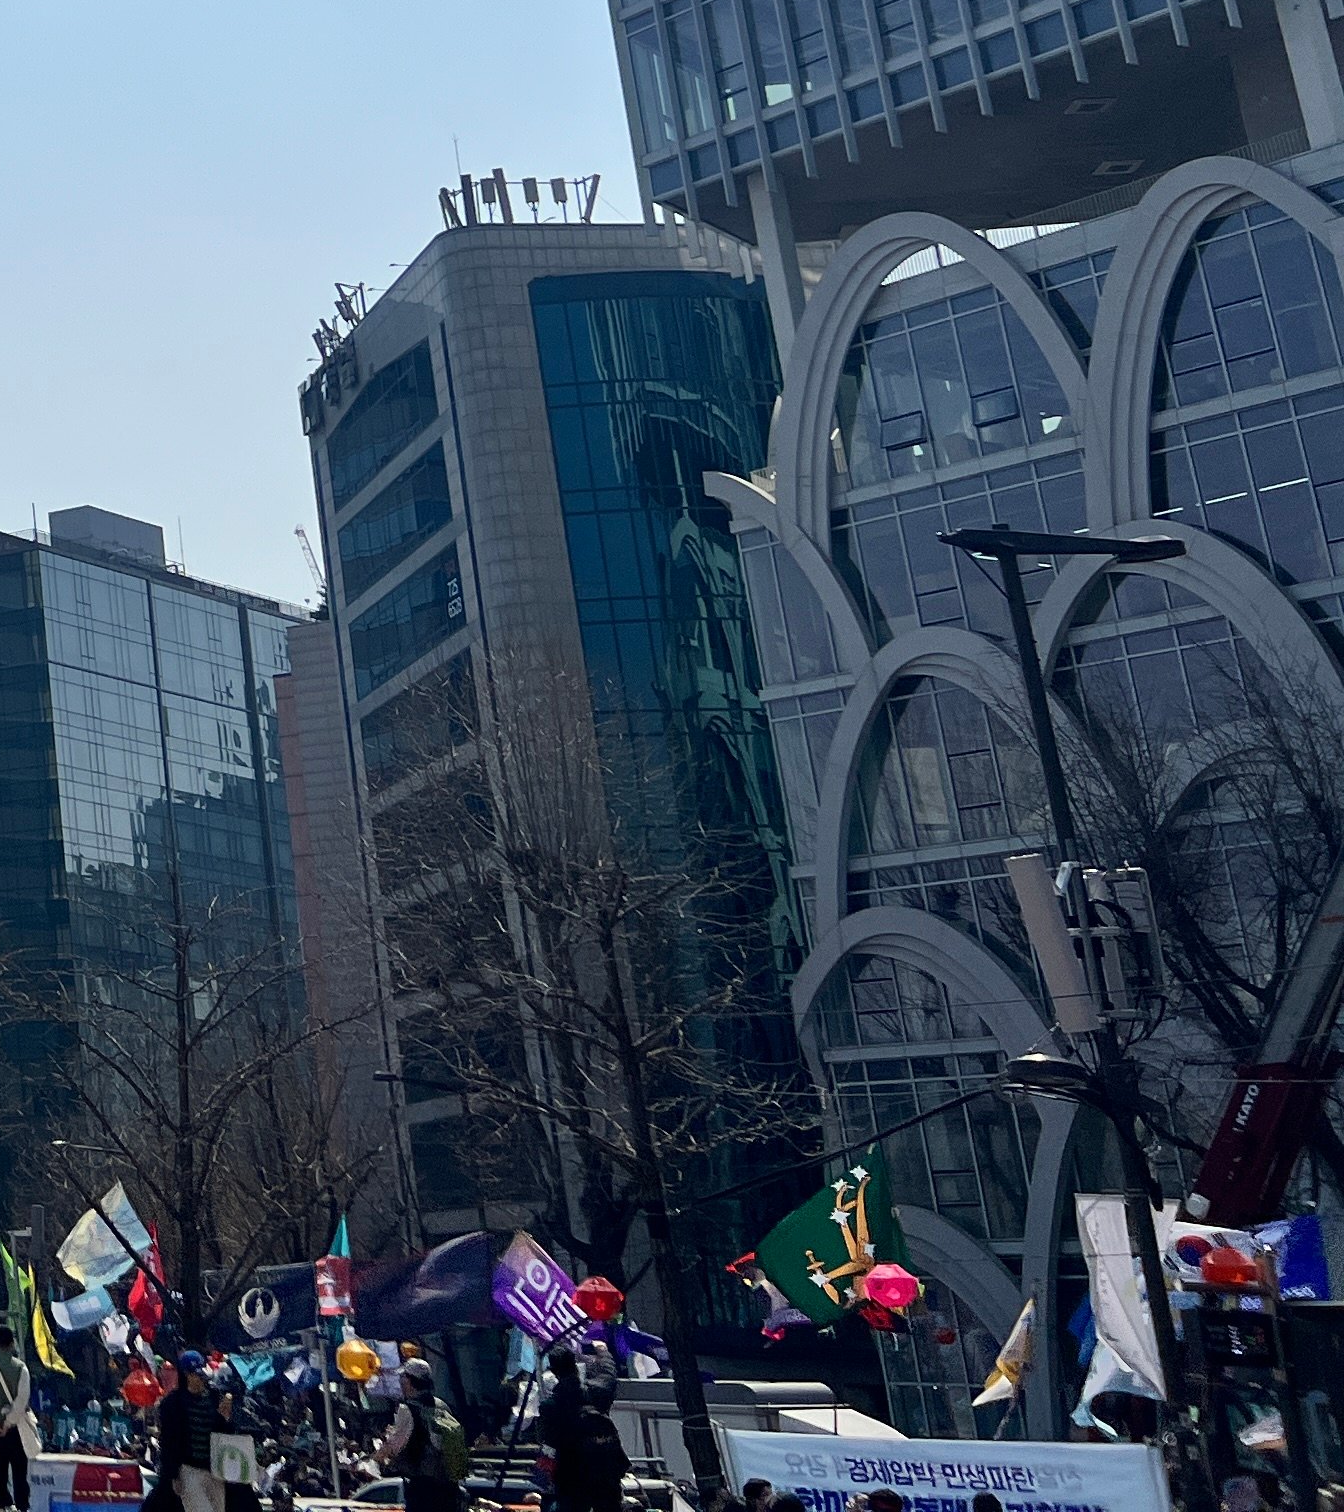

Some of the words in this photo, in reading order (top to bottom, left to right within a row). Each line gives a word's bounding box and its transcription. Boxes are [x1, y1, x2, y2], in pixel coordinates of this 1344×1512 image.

[1235, 1084, 1260, 1126] KATO
[845, 1455, 936, 1486] 경제압박
[940, 1460, 1039, 1495] 민생파탄
